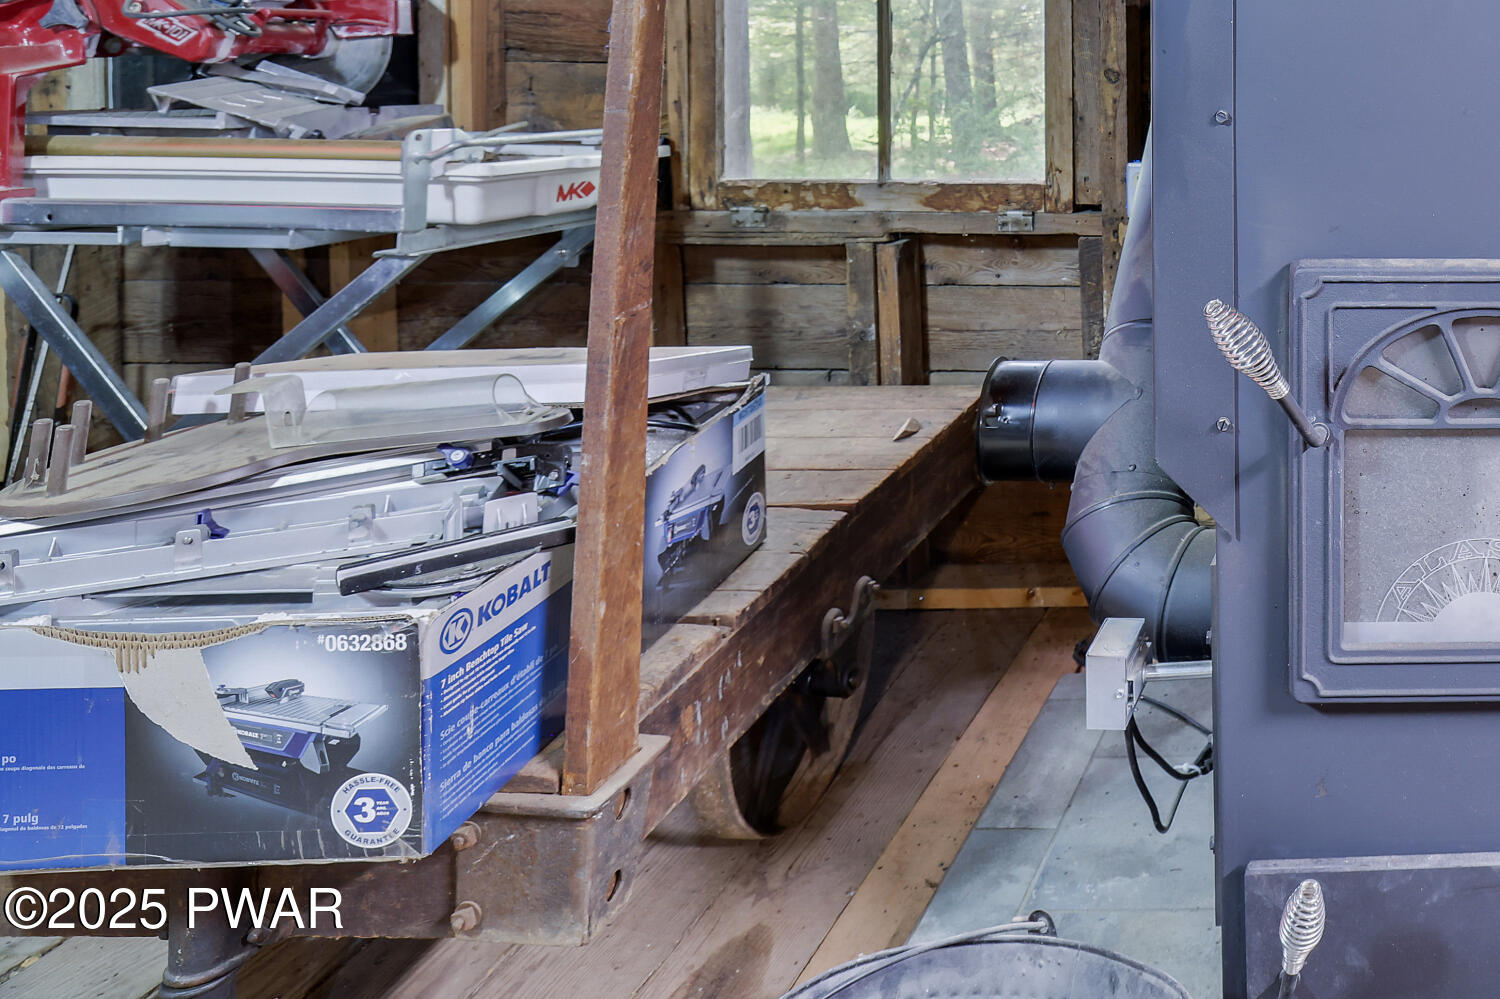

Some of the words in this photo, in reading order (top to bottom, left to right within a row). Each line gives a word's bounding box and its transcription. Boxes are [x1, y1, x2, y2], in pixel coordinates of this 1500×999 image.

[556, 181, 585, 203] MK
[478, 560, 551, 627] KOBALT
[317, 634, 407, 652] #0632868
[448, 667, 464, 684] inch
[466, 644, 500, 671] Benchtop
[501, 633, 513, 648] Tile
[2, 755, 17, 766] po
[440, 771, 461, 792] Sierra
[473, 743, 494, 764] banco
[495, 728, 510, 748] para
[343, 776, 401, 794] HASSLE-FREE
[2, 814, 9, 824] 7
[13, 812, 39, 826] pulg
[353, 796, 376, 823] 3
